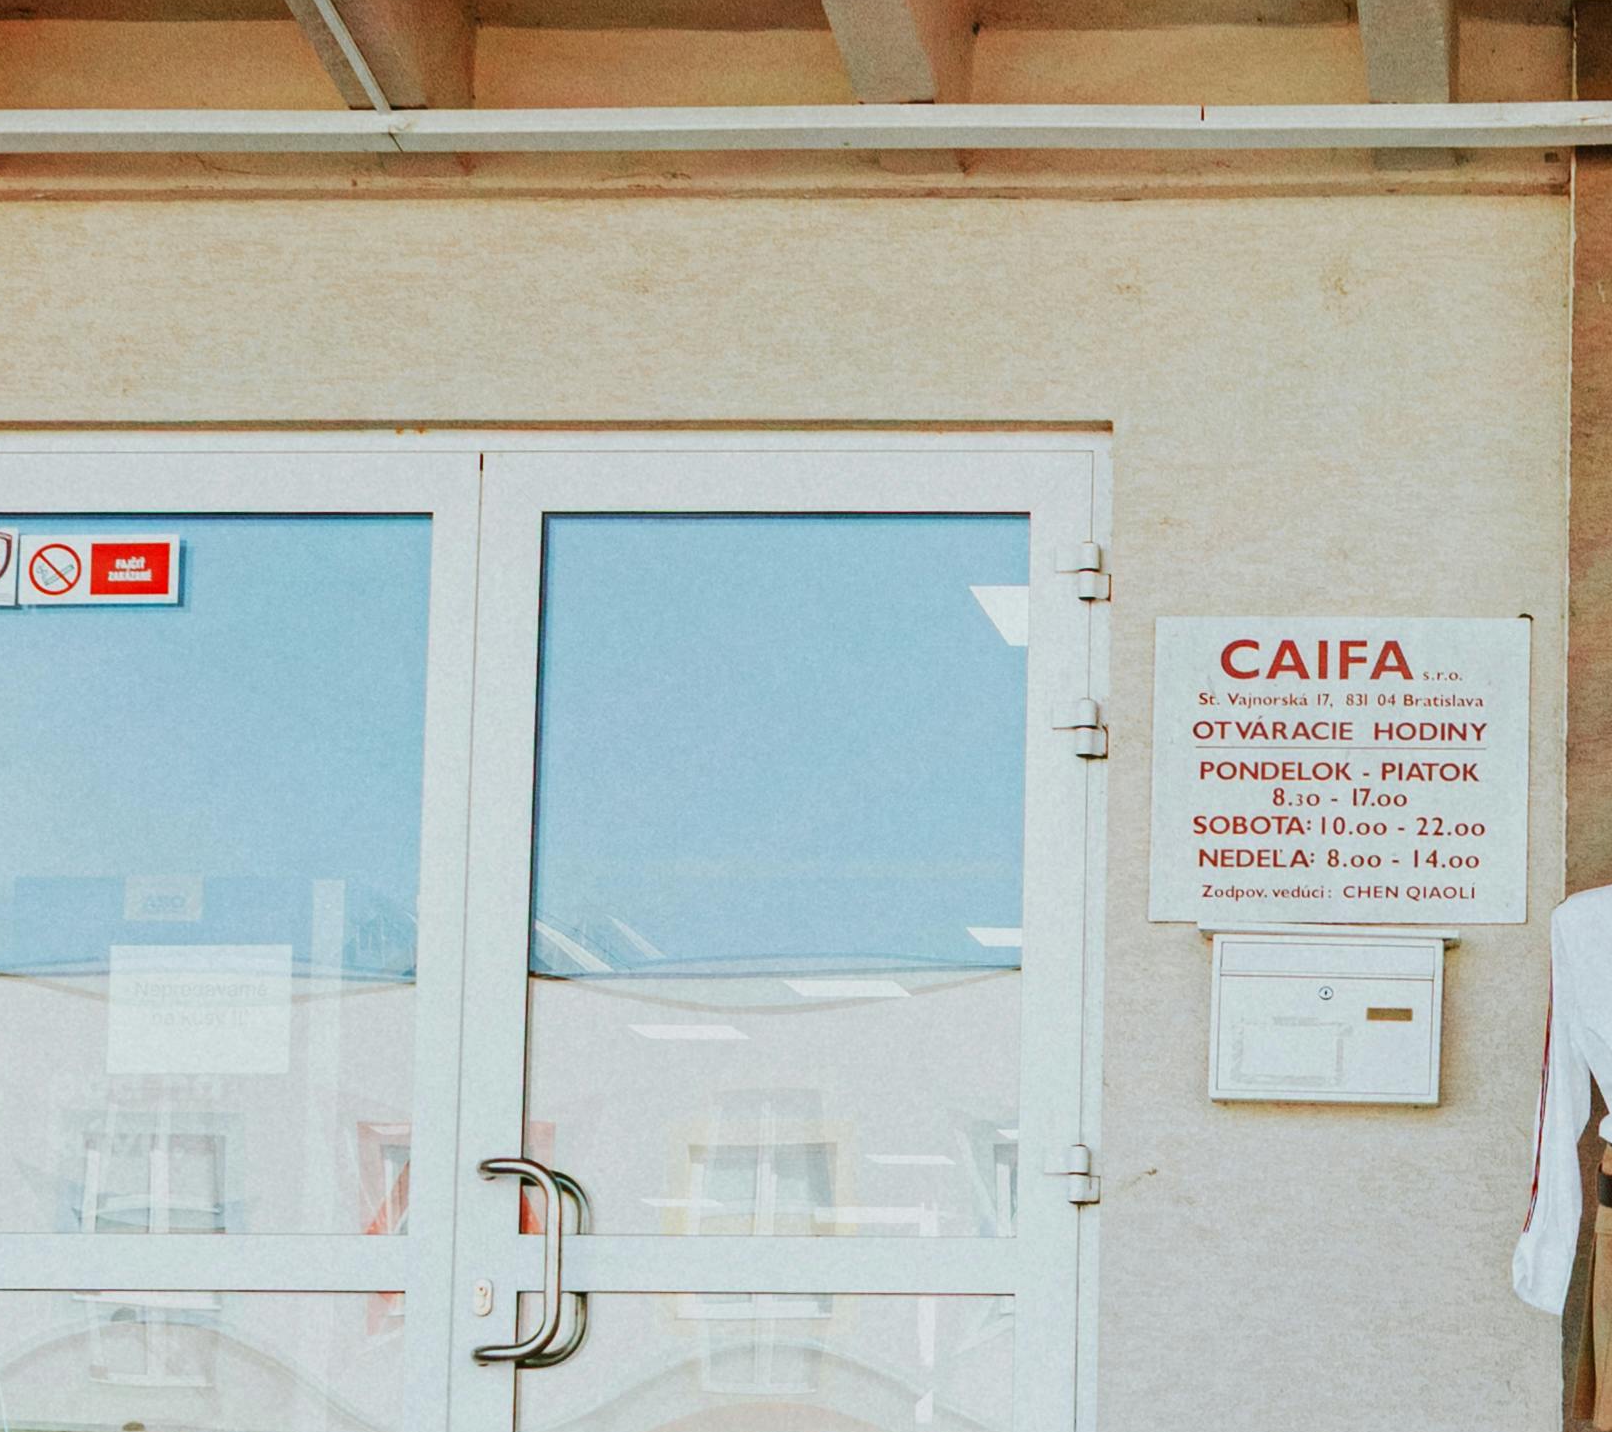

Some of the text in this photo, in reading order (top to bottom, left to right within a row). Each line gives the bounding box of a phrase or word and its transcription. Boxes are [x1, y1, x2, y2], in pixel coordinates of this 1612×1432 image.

[1221, 639, 1462, 680] CAIFA s.r.o.
[1199, 693, 1483, 708] St. Vajnorská 17, 831 04 Bratislava
[1193, 715, 1487, 741] OTVÁRACIE HODINY
[1200, 761, 1351, 781] PONDELOK
[1382, 762, 1479, 781] PIATOK
[1273, 788, 1320, 806] 8.30
[1353, 788, 1407, 807] 17.00
[1193, 816, 1311, 835] SOBOTA:
[1322, 817, 1387, 835] 10.00
[1417, 817, 1485, 836] 22.00
[1199, 849, 1314, 867] NEDEĽA:
[1327, 849, 1381, 868] 8.00
[1414, 850, 1479, 868] 14.00
[1202, 885, 1267, 901] Zodpov.
[1343, 886, 1398, 898] CHEN
